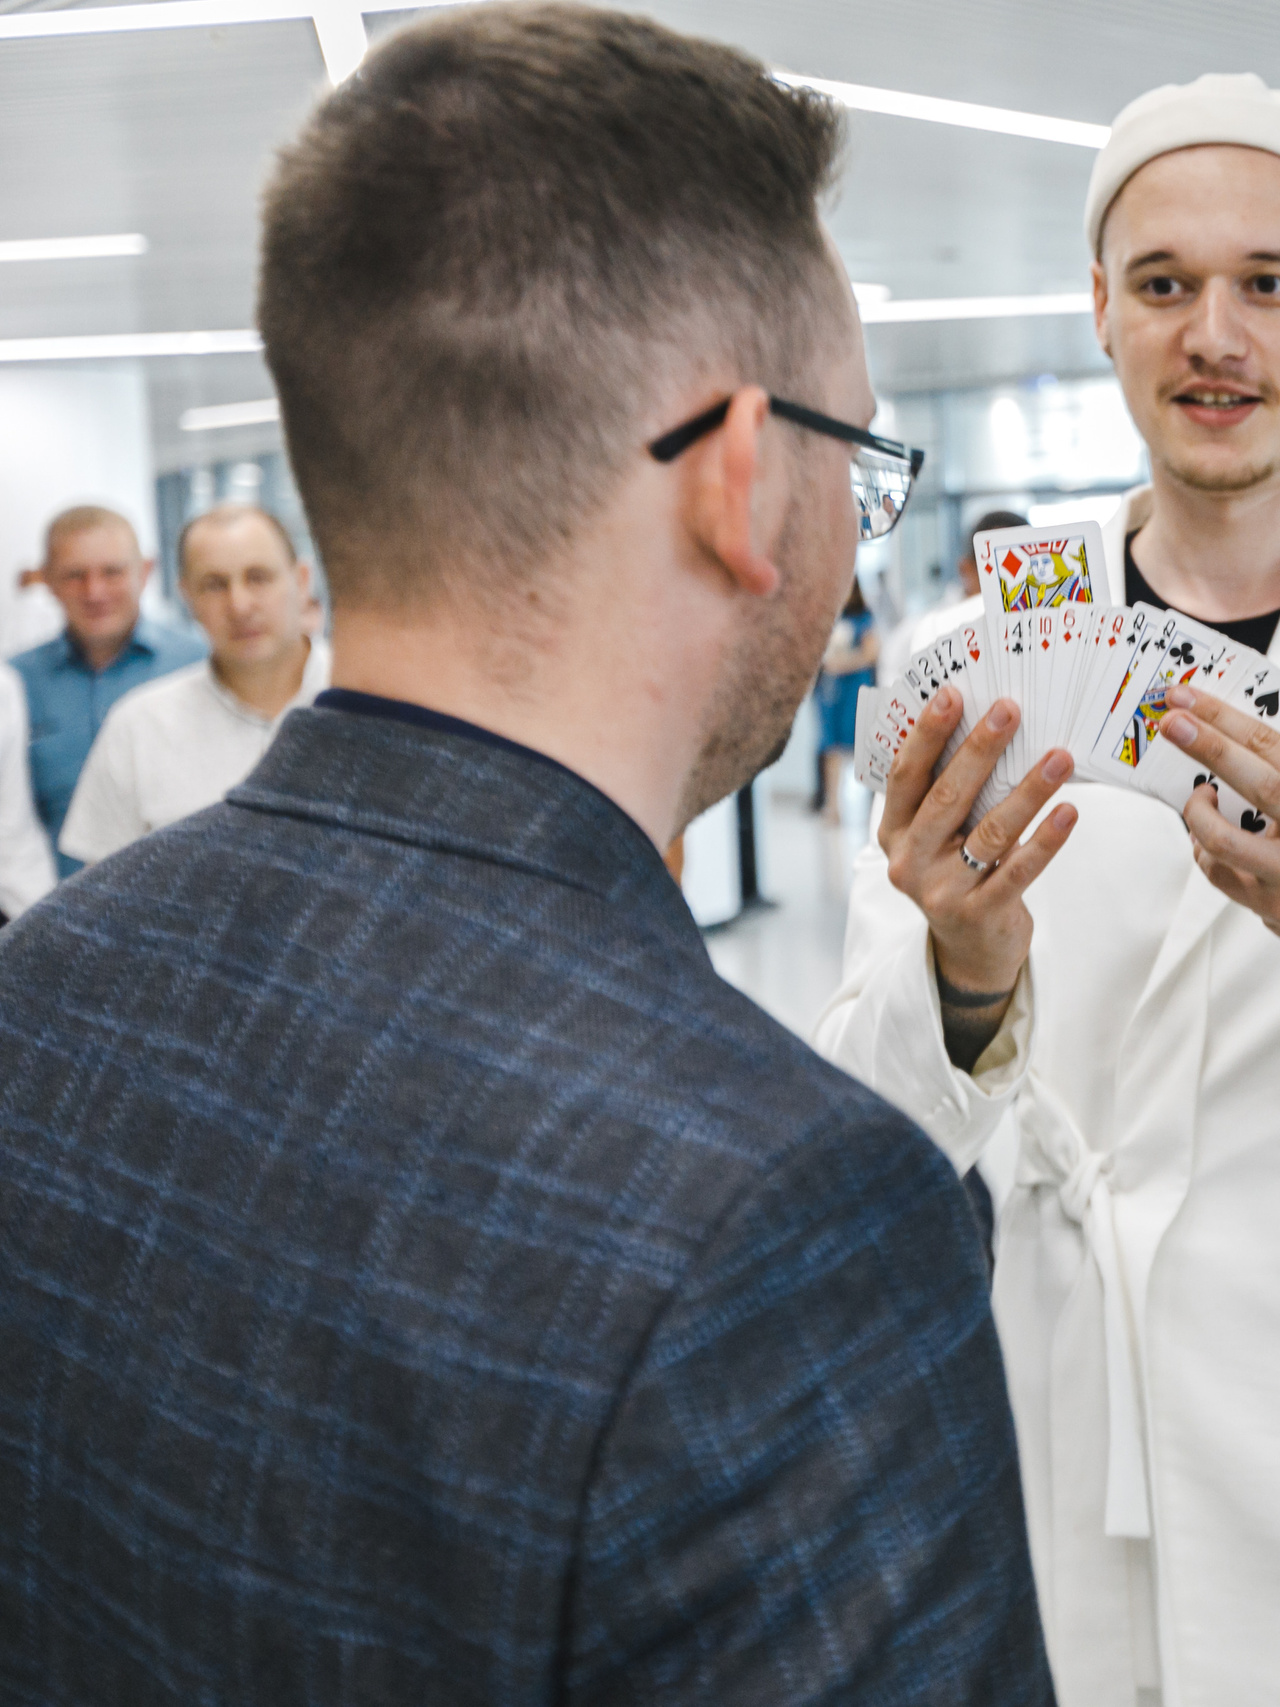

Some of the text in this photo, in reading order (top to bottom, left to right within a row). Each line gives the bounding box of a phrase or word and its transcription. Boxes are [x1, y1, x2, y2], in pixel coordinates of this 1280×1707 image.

[981, 540, 991, 561] J
[1040, 616, 1053, 637] 10
[1064, 609, 1076, 629] 6
[1113, 615, 1124, 635] Q
[1134, 612, 1146, 631] Q
[965, 628, 978, 650] 2
[1012, 620, 1023, 639] 4
[1163, 621, 1176, 638] Q
[942, 639, 952, 659] 7
[919, 657, 934, 678] 2
[891, 699, 907, 718] 3
[887, 713, 900, 732] J
[876, 732, 891, 750] 5
